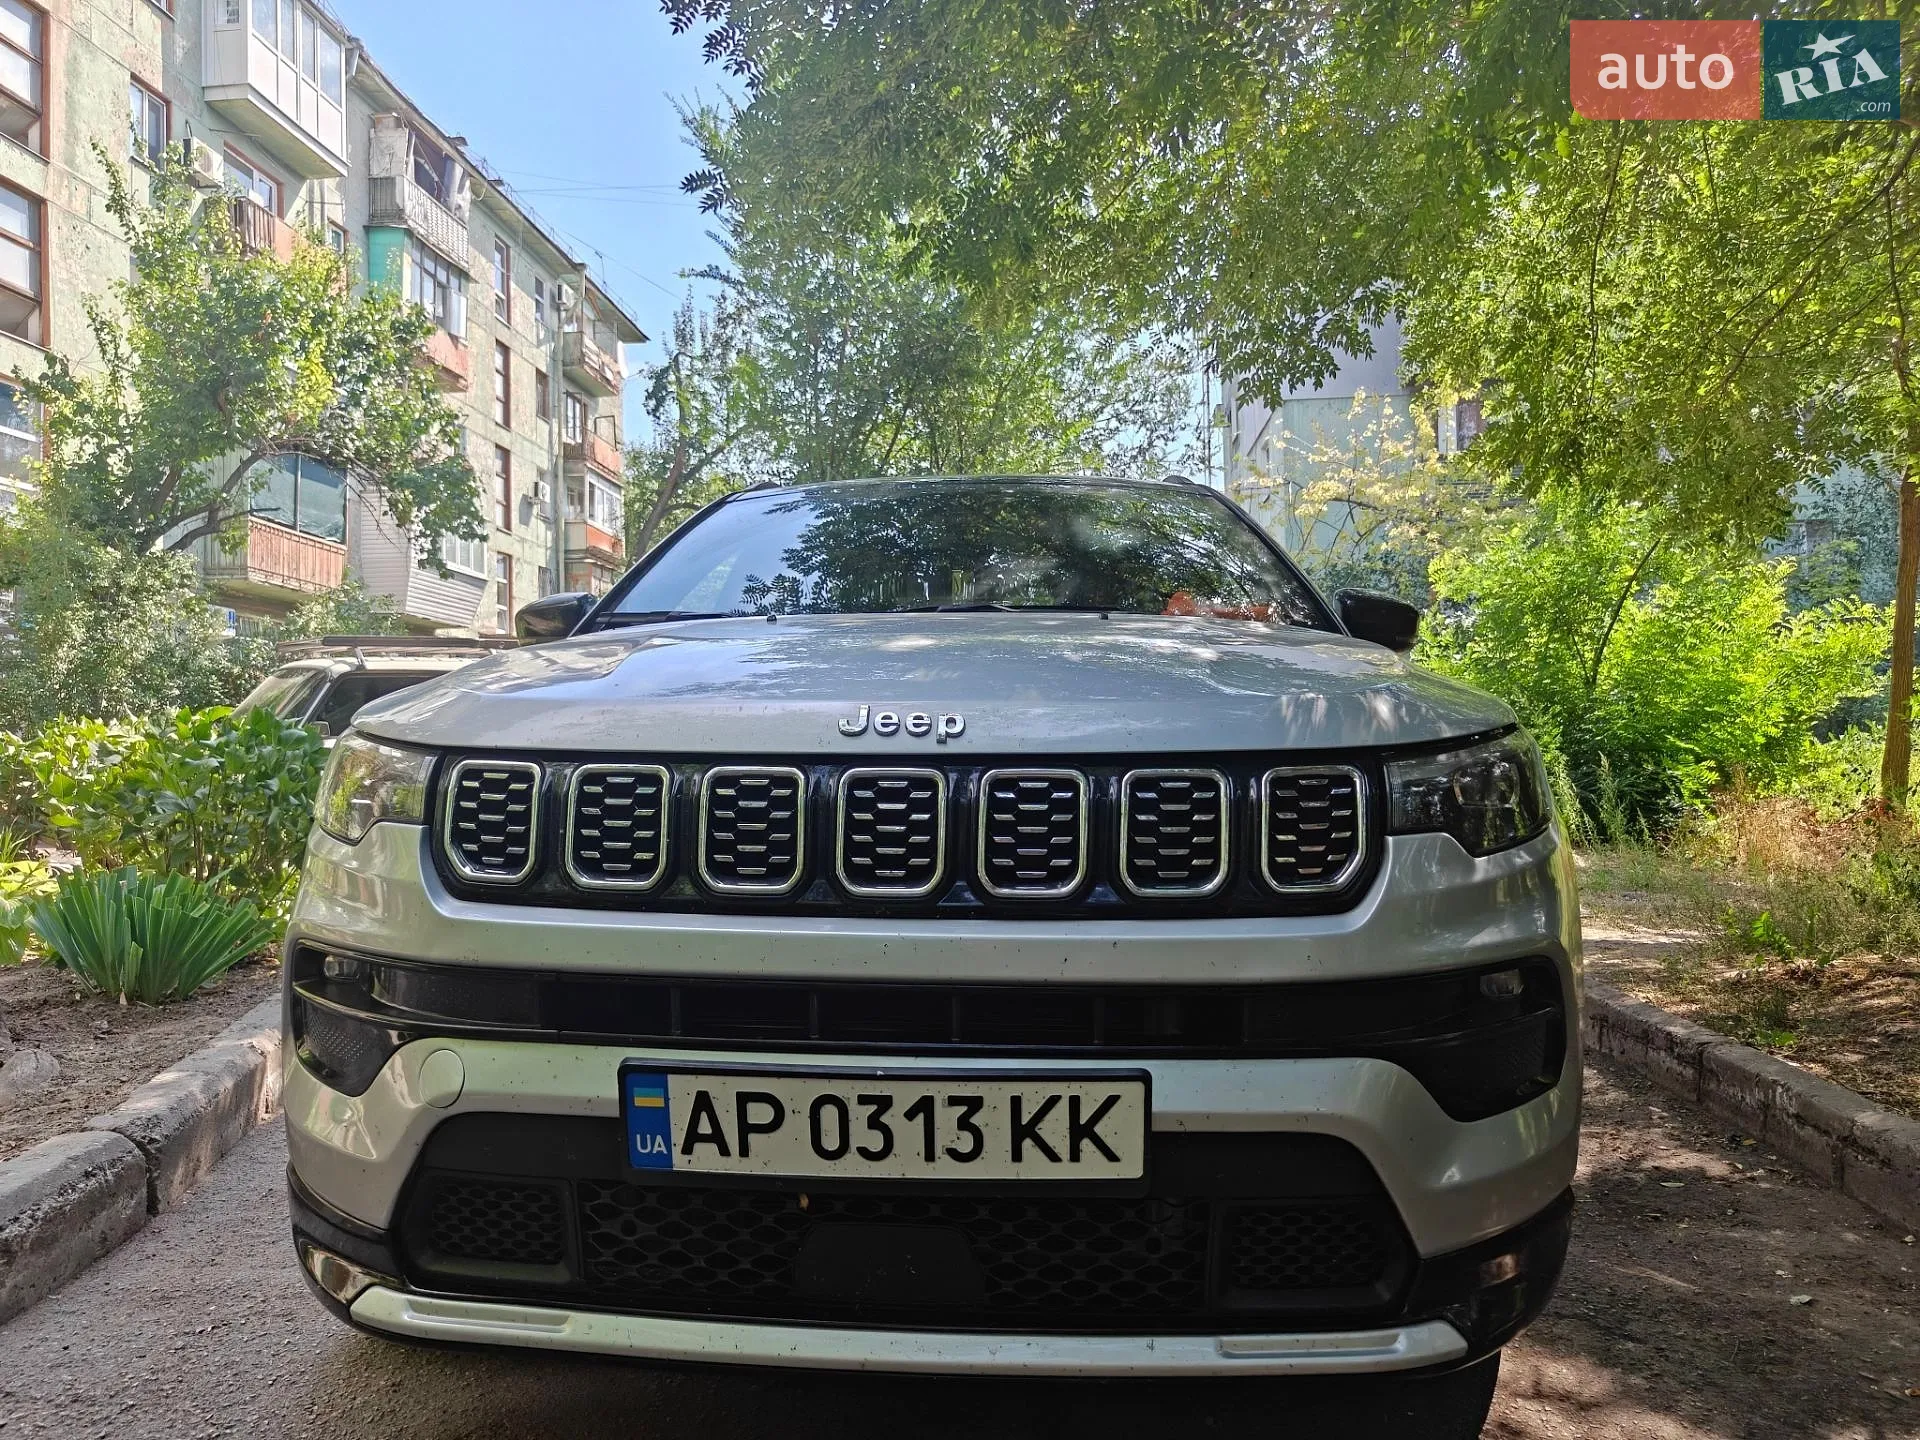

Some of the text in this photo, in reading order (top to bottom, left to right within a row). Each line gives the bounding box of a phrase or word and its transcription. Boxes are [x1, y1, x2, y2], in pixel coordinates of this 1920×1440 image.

[838, 704, 967, 744] Jeep
[636, 1134, 668, 1154] UA
[680, 1090, 1122, 1163] AP 0313 KK
